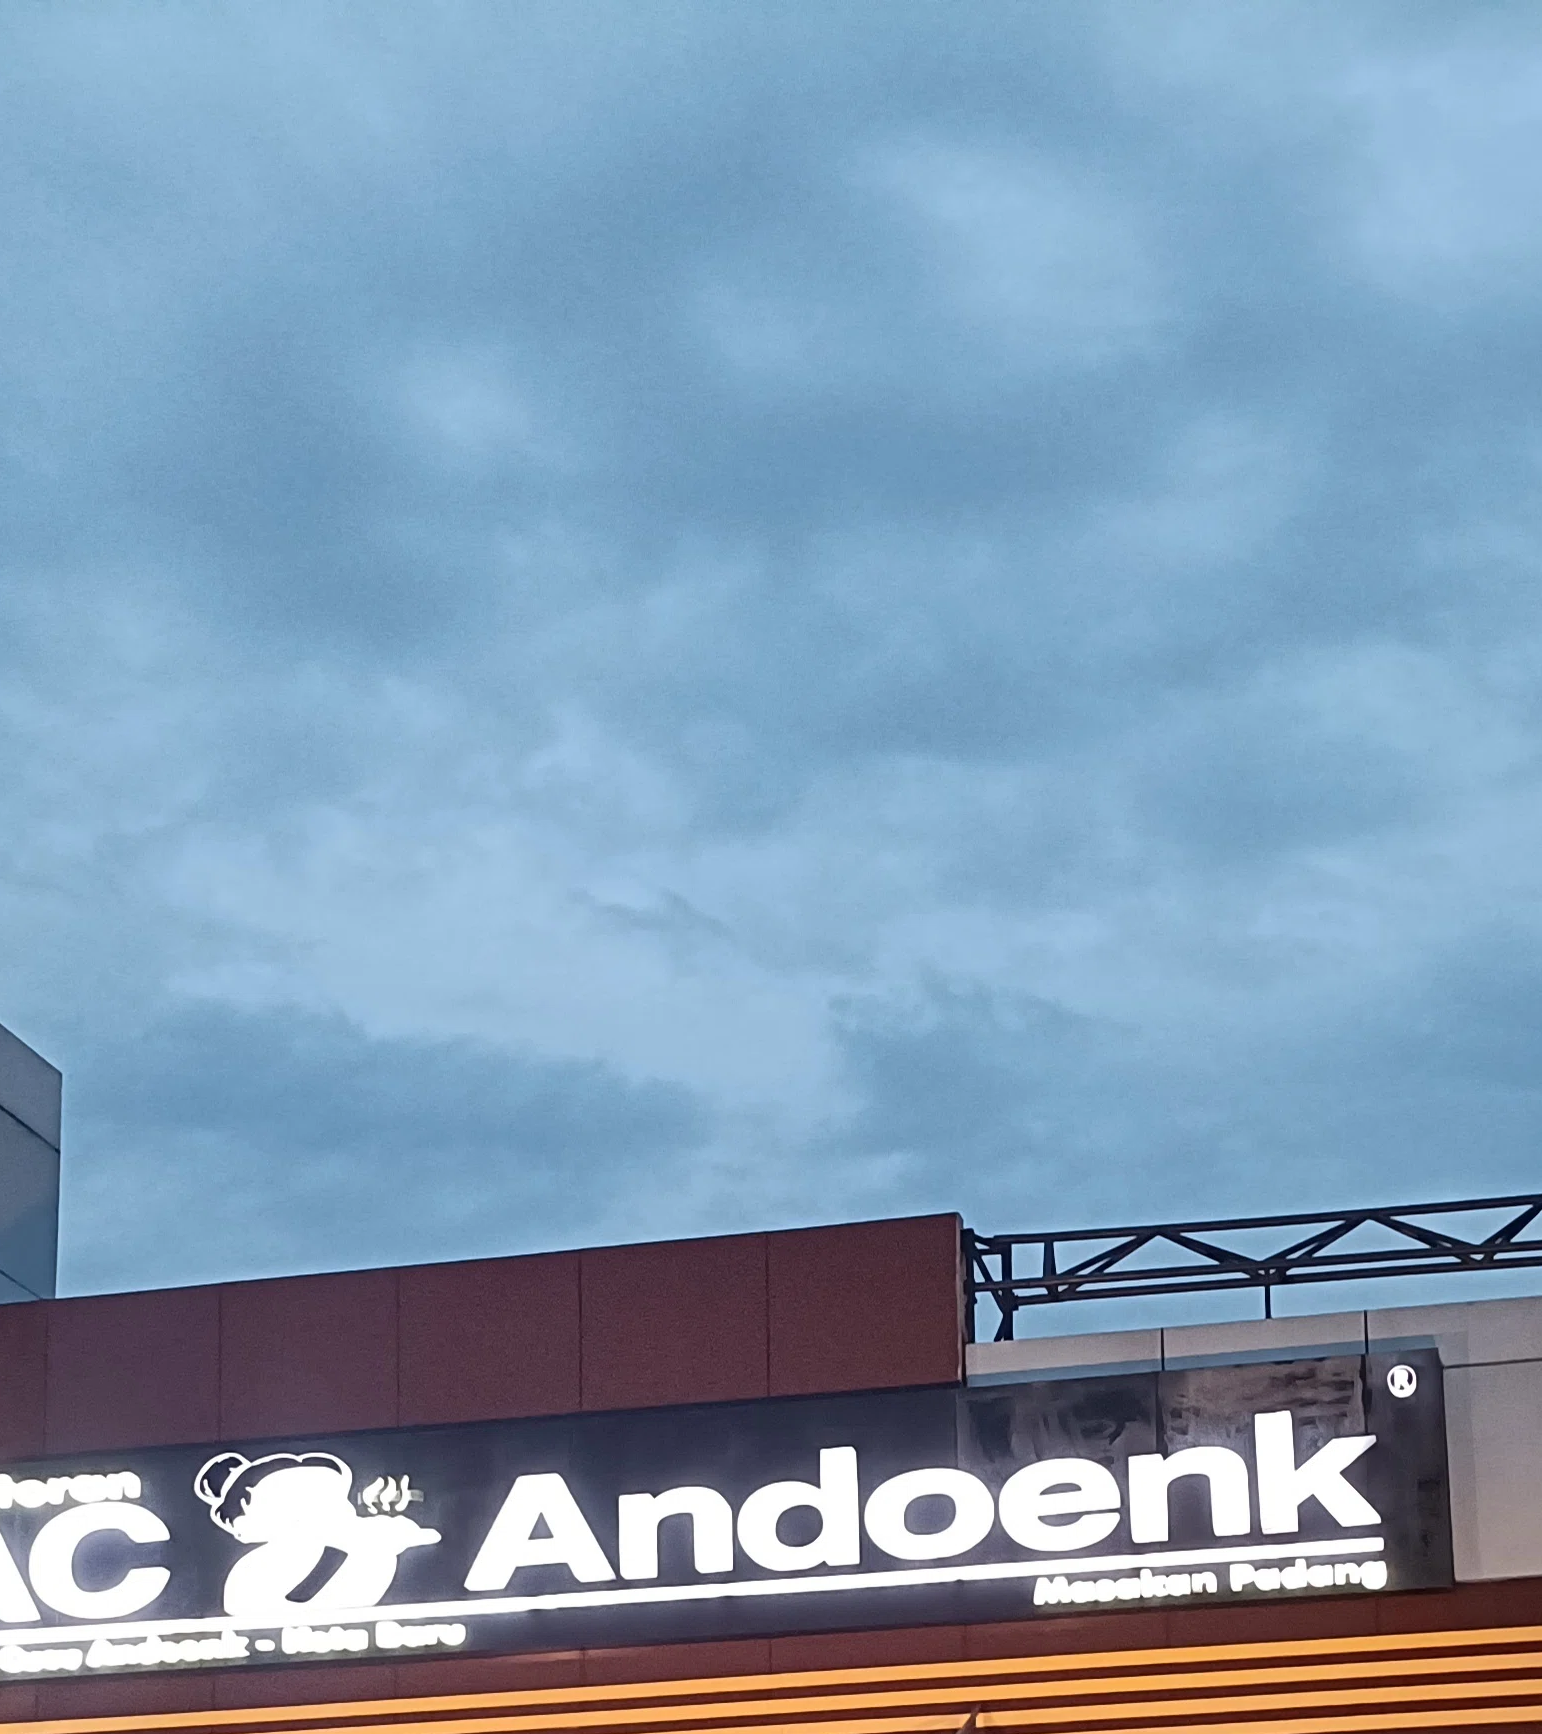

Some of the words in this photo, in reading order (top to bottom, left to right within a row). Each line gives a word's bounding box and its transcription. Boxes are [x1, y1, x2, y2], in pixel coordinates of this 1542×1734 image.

[464, 1410, 1382, 1591] Andoenk
[1033, 1568, 1218, 1605] Masakan
[1229, 1558, 1388, 1591] Padang
